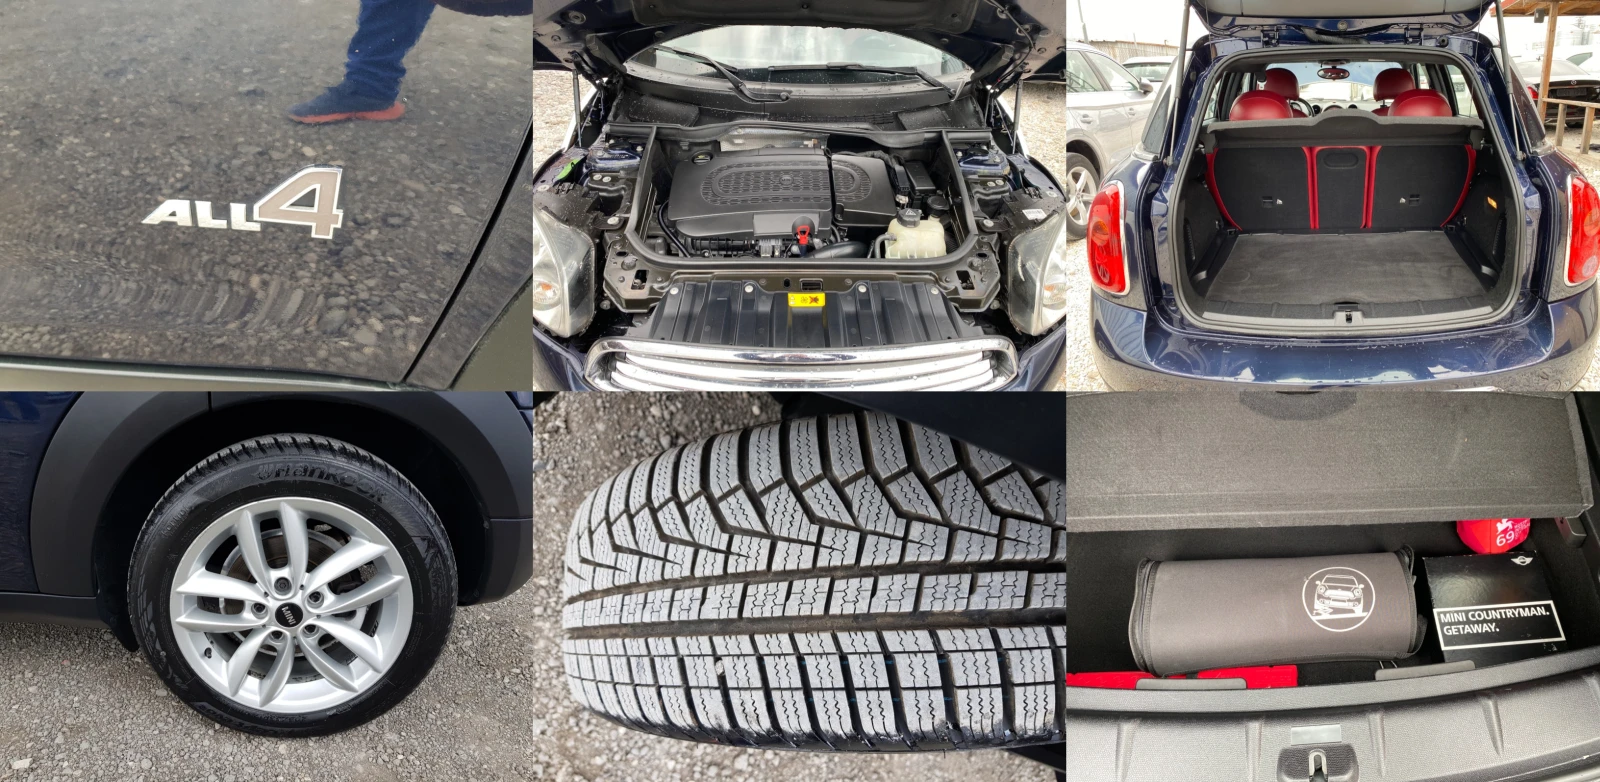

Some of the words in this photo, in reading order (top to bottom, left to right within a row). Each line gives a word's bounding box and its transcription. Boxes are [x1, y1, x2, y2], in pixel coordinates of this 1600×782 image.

[141, 163, 344, 240] ALL4
[1496, 530, 1515, 547] 69
[281, 605, 297, 625] MINI
[1440, 611, 1467, 623] MINI
[1468, 605, 1550, 621] COUNTRYMAN.
[1443, 622, 1500, 636] GETAWAY.
